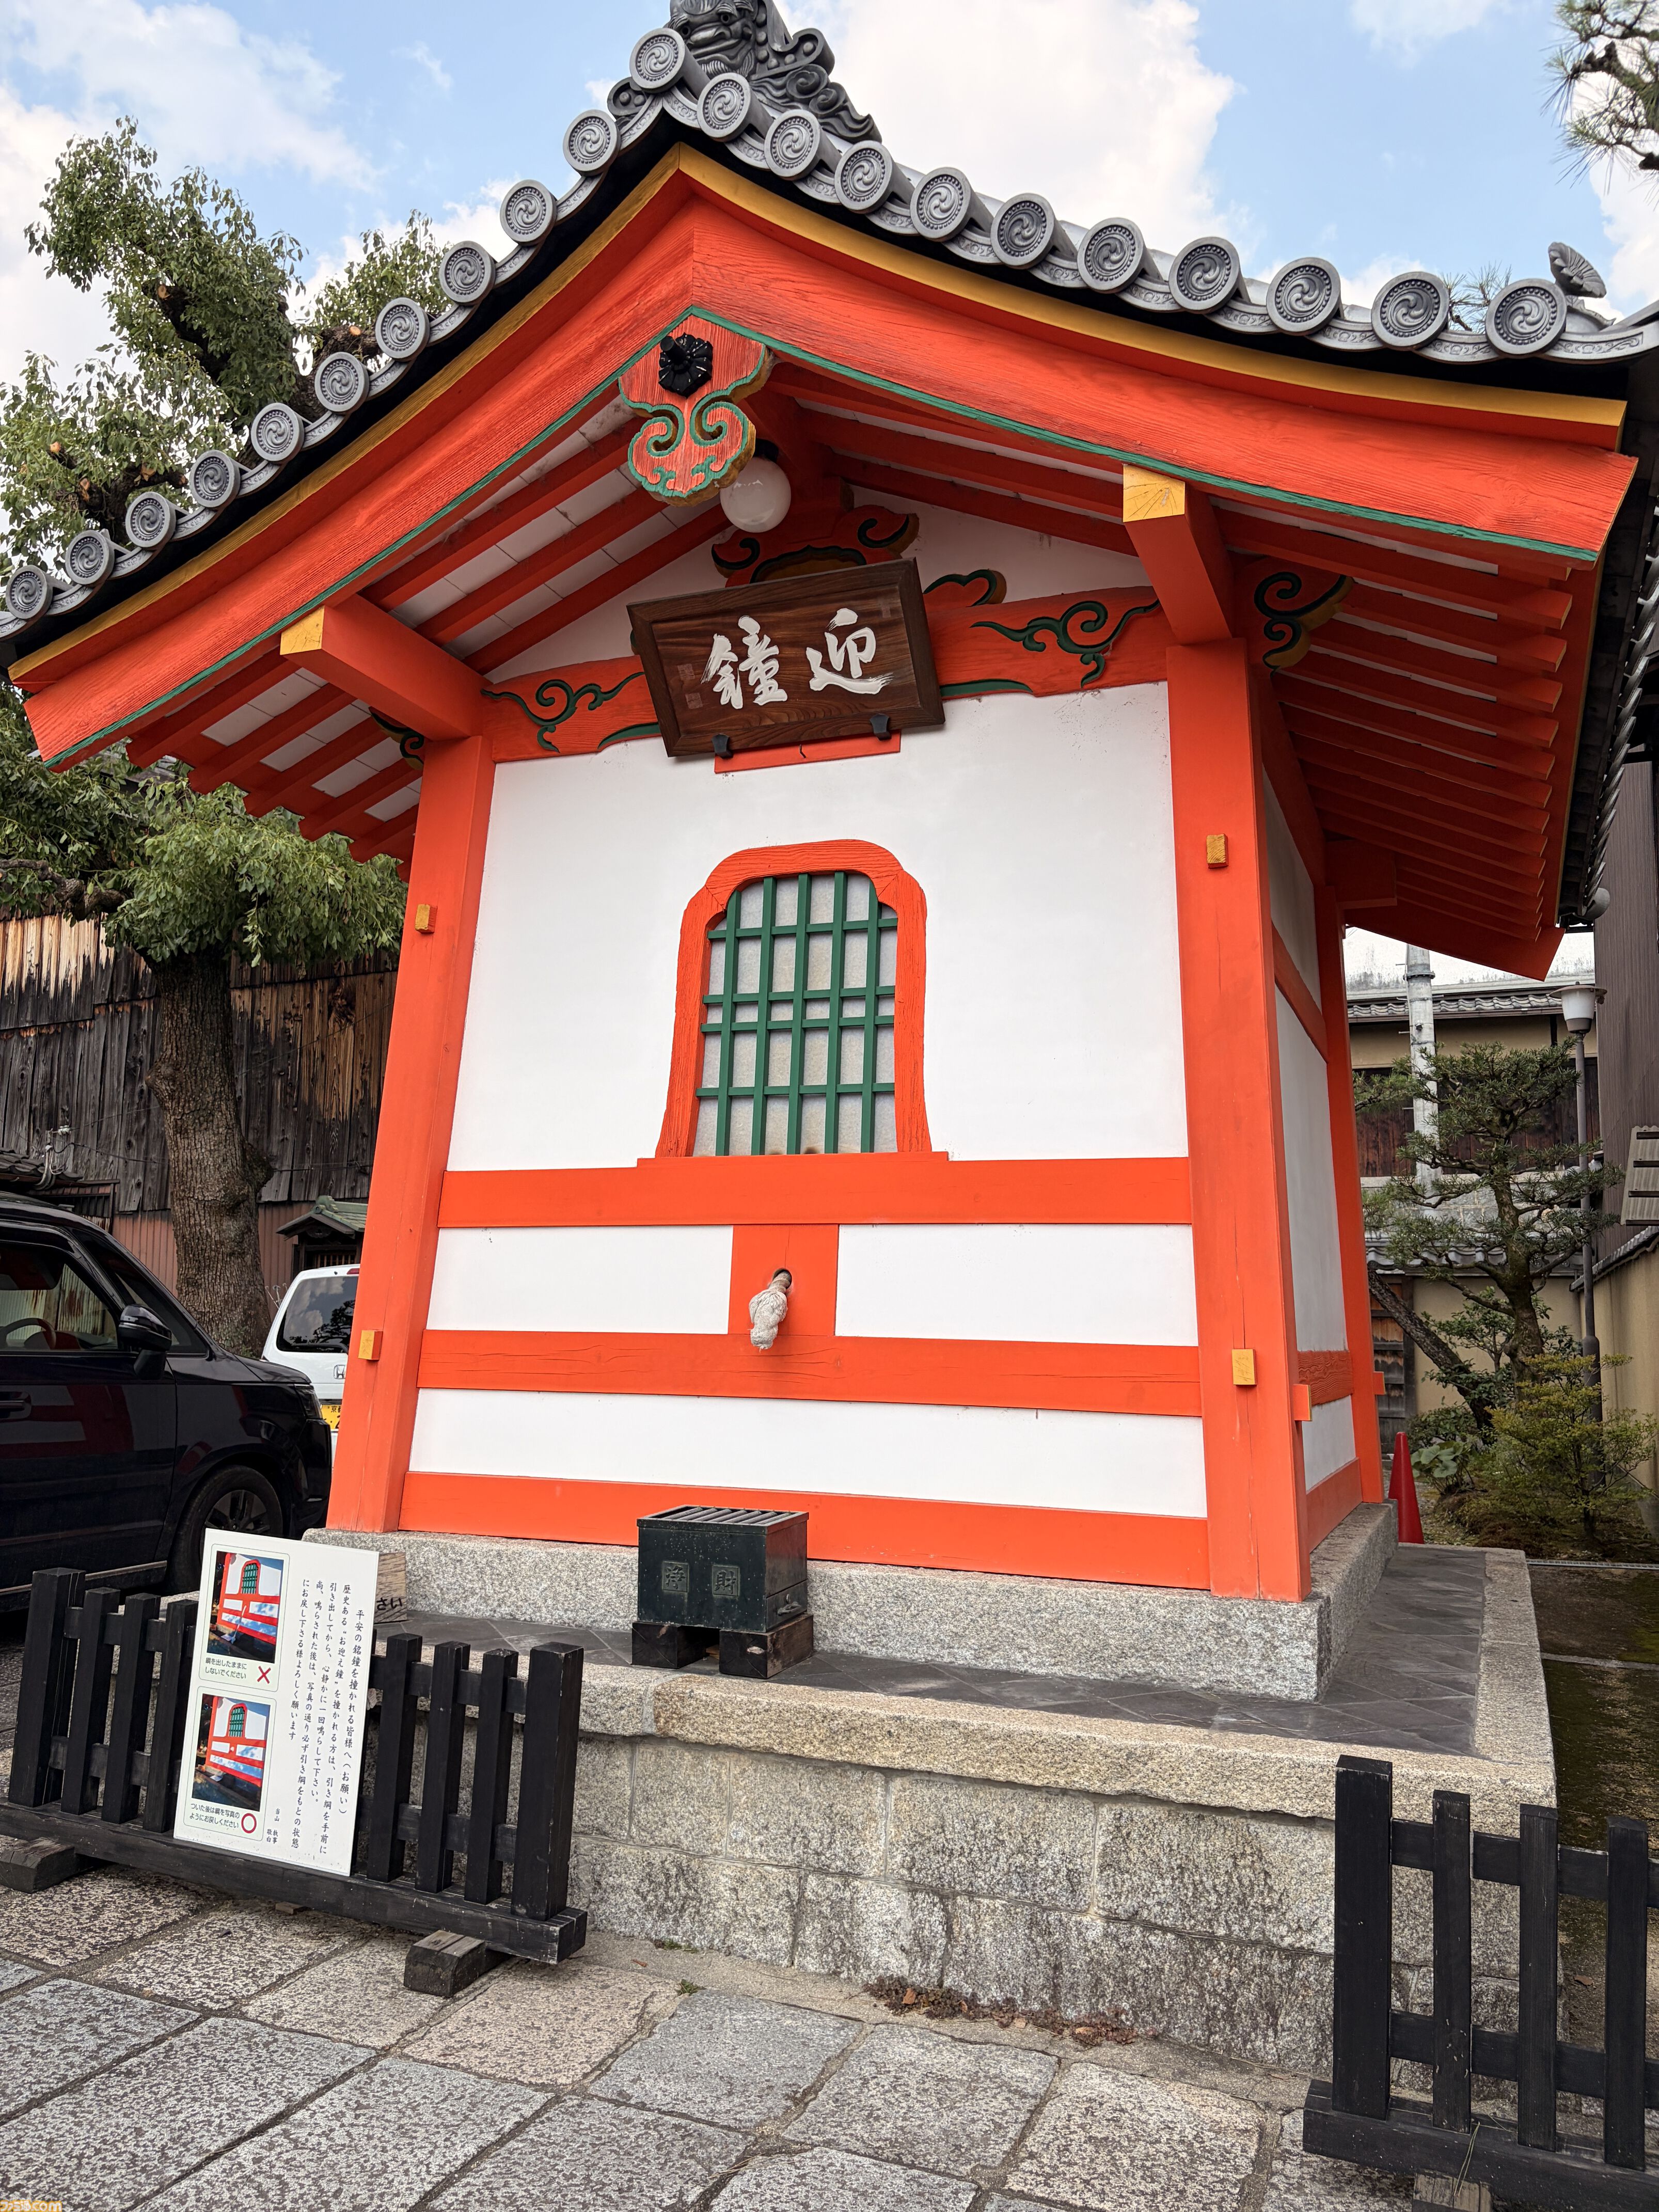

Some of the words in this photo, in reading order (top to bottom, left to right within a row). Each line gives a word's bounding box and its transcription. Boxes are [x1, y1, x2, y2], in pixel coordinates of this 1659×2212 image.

[701, 608, 893, 709] 迎鐘
[205, 1667, 246, 1679] しないでください
[289, 1579, 310, 1740] にお戻し下さる様よろしく願います
[189, 1813, 239, 1828] ようにお戻しください
